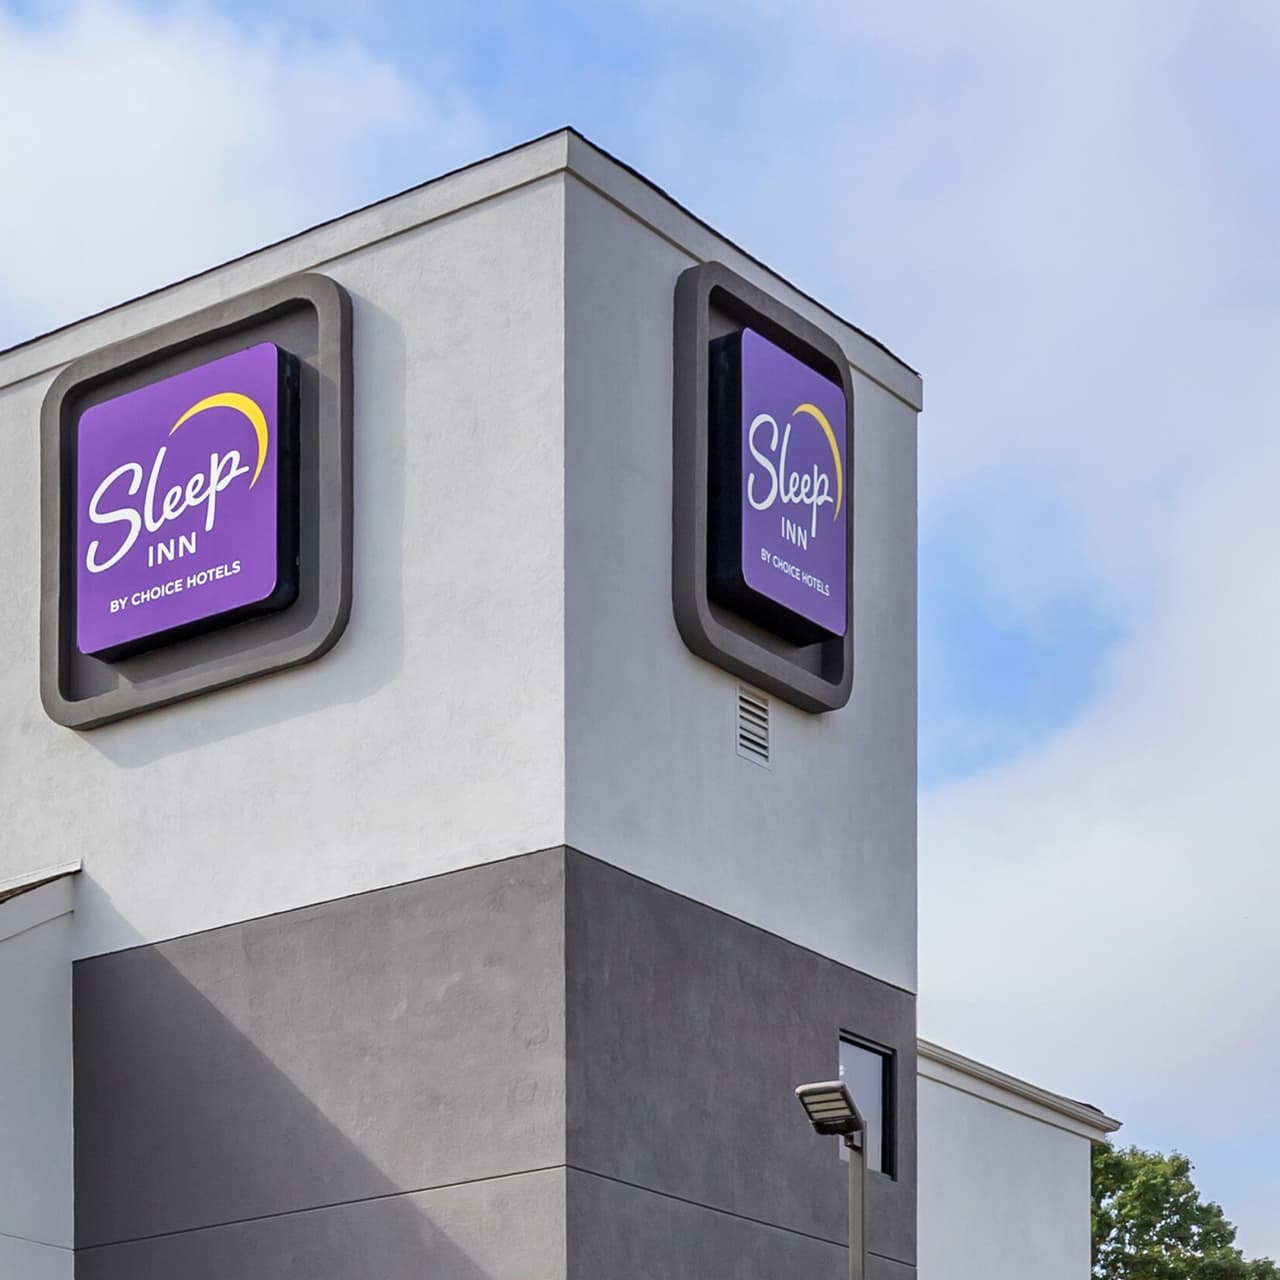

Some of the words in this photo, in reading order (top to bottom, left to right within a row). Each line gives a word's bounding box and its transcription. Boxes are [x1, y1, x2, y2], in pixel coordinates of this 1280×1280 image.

[747, 413, 833, 538] Sleep
[85, 446, 250, 574] Sleep
[781, 516, 807, 551] INN
[148, 532, 197, 568] INN
[761, 547, 771, 563] BY
[772, 555, 800, 581] CHOICE
[802, 571, 830, 597] HOTELS
[110, 597, 128, 614] BY
[131, 579, 183, 606] CHOICE
[187, 560, 241, 588] HOTELS
